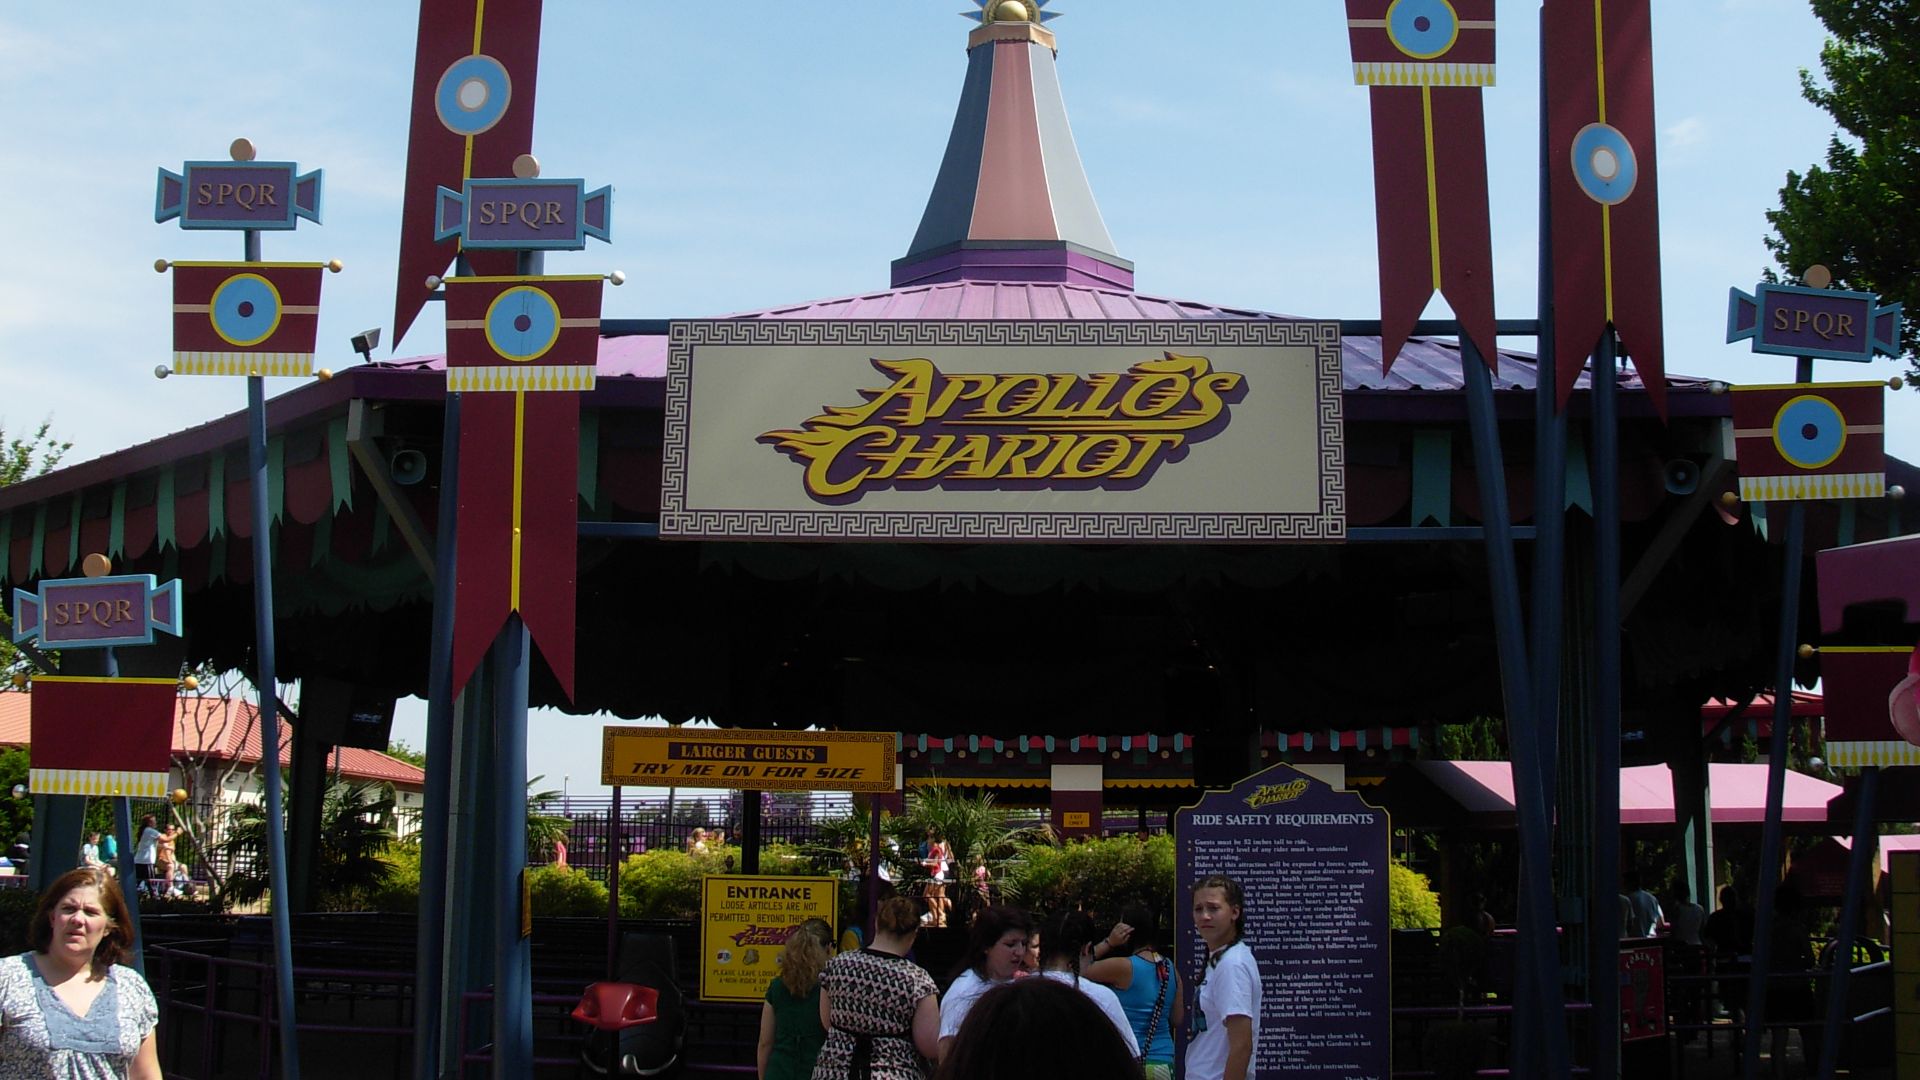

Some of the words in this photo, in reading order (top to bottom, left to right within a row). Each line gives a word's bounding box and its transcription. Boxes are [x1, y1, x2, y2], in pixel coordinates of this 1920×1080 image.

[197, 183, 278, 210] SPQR
[480, 201, 565, 230] SPQR
[1774, 307, 1855, 340] SPQR
[756, 425, 1187, 500] CHARIOT
[55, 600, 135, 628] SPQR
[680, 744, 747, 760] LARGER
[753, 746, 817, 761] GUESTS
[631, 762, 675, 774] TRY
[680, 764, 715, 776] ME
[722, 765, 756, 777] ON
[762, 766, 808, 778] FOR
[815, 767, 866, 780] SIZE
[1192, 814, 1223, 825] RIDE
[1226, 814, 1272, 825] SAFETY
[1275, 813, 1375, 827] REQUIREMENTS
[727, 885, 812, 900] ENTRANCE
[720, 900, 745, 910] LOOSE
[748, 901, 783, 911] ARTICLES
[786, 902, 800, 911] ARE
[803, 903, 818, 912] NOT
[709, 913, 750, 922] PERMITTED
[756, 913, 785, 923] BEYOND
[789, 914, 804, 923] THIS
